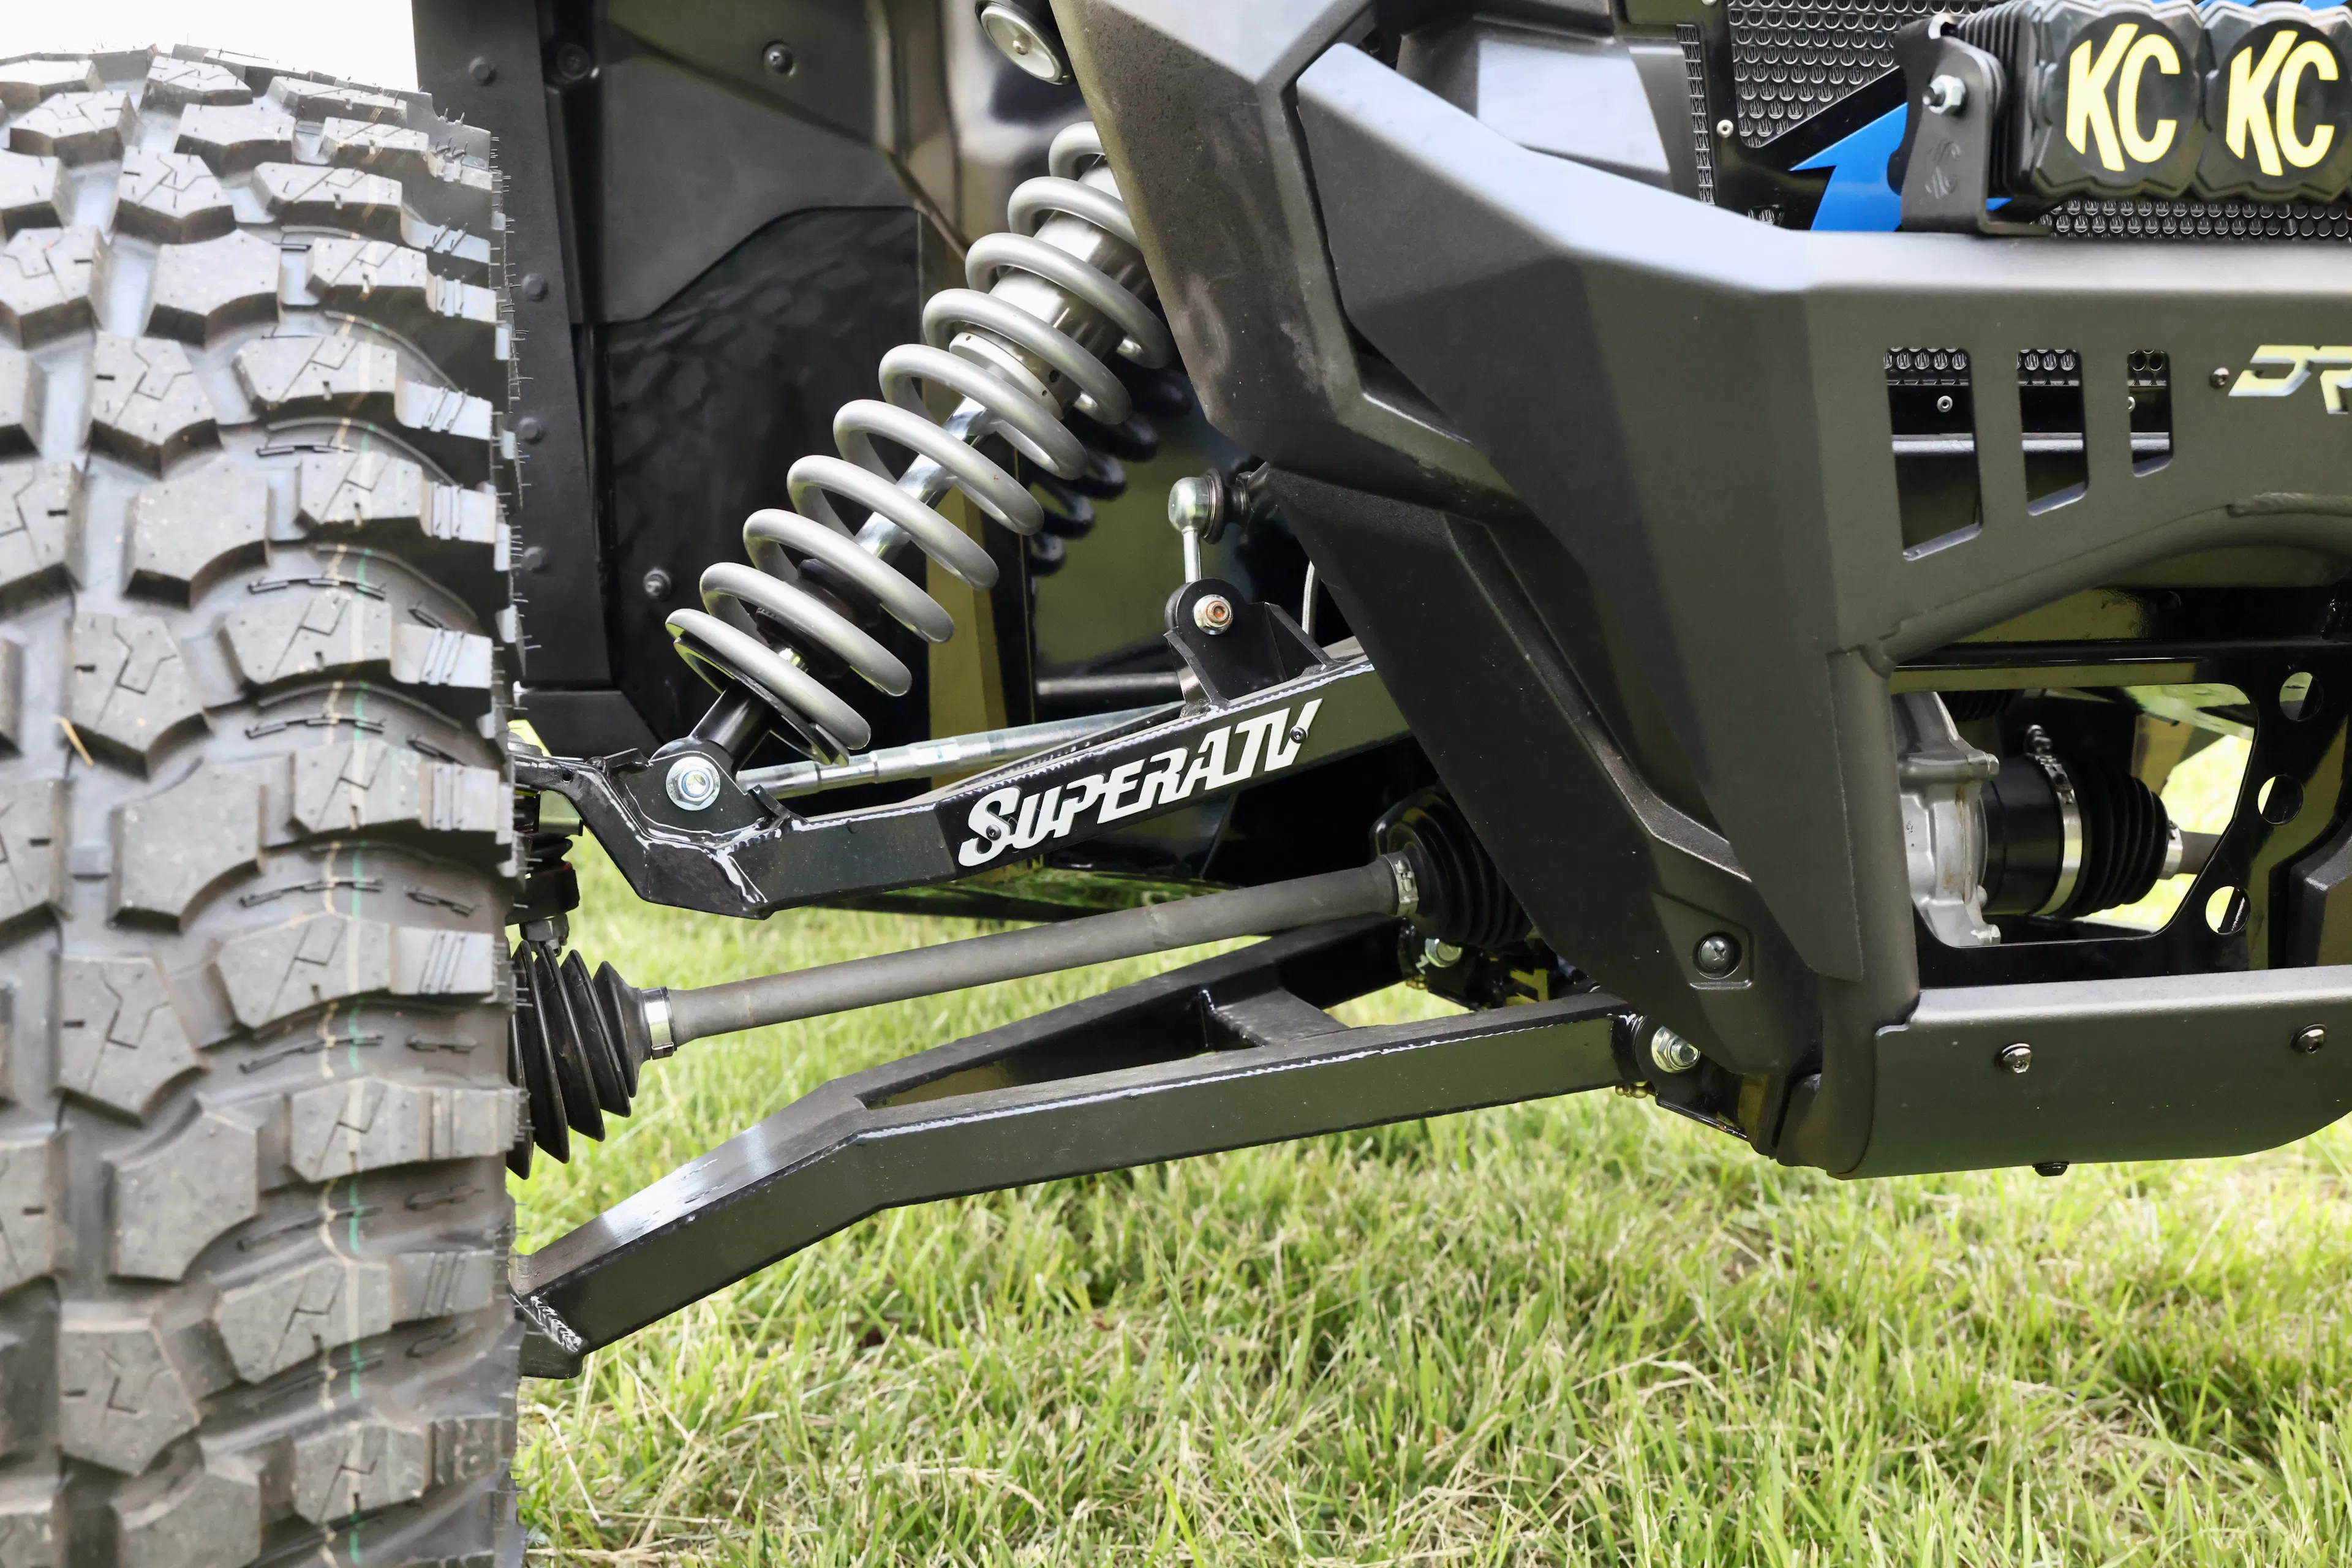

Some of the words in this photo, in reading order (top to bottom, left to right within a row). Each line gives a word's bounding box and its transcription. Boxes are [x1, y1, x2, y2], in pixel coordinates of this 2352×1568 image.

[2066, 23, 2180, 172] KC
[2225, 31, 2339, 176] KC
[958, 698, 1323, 867] SUPERATV
